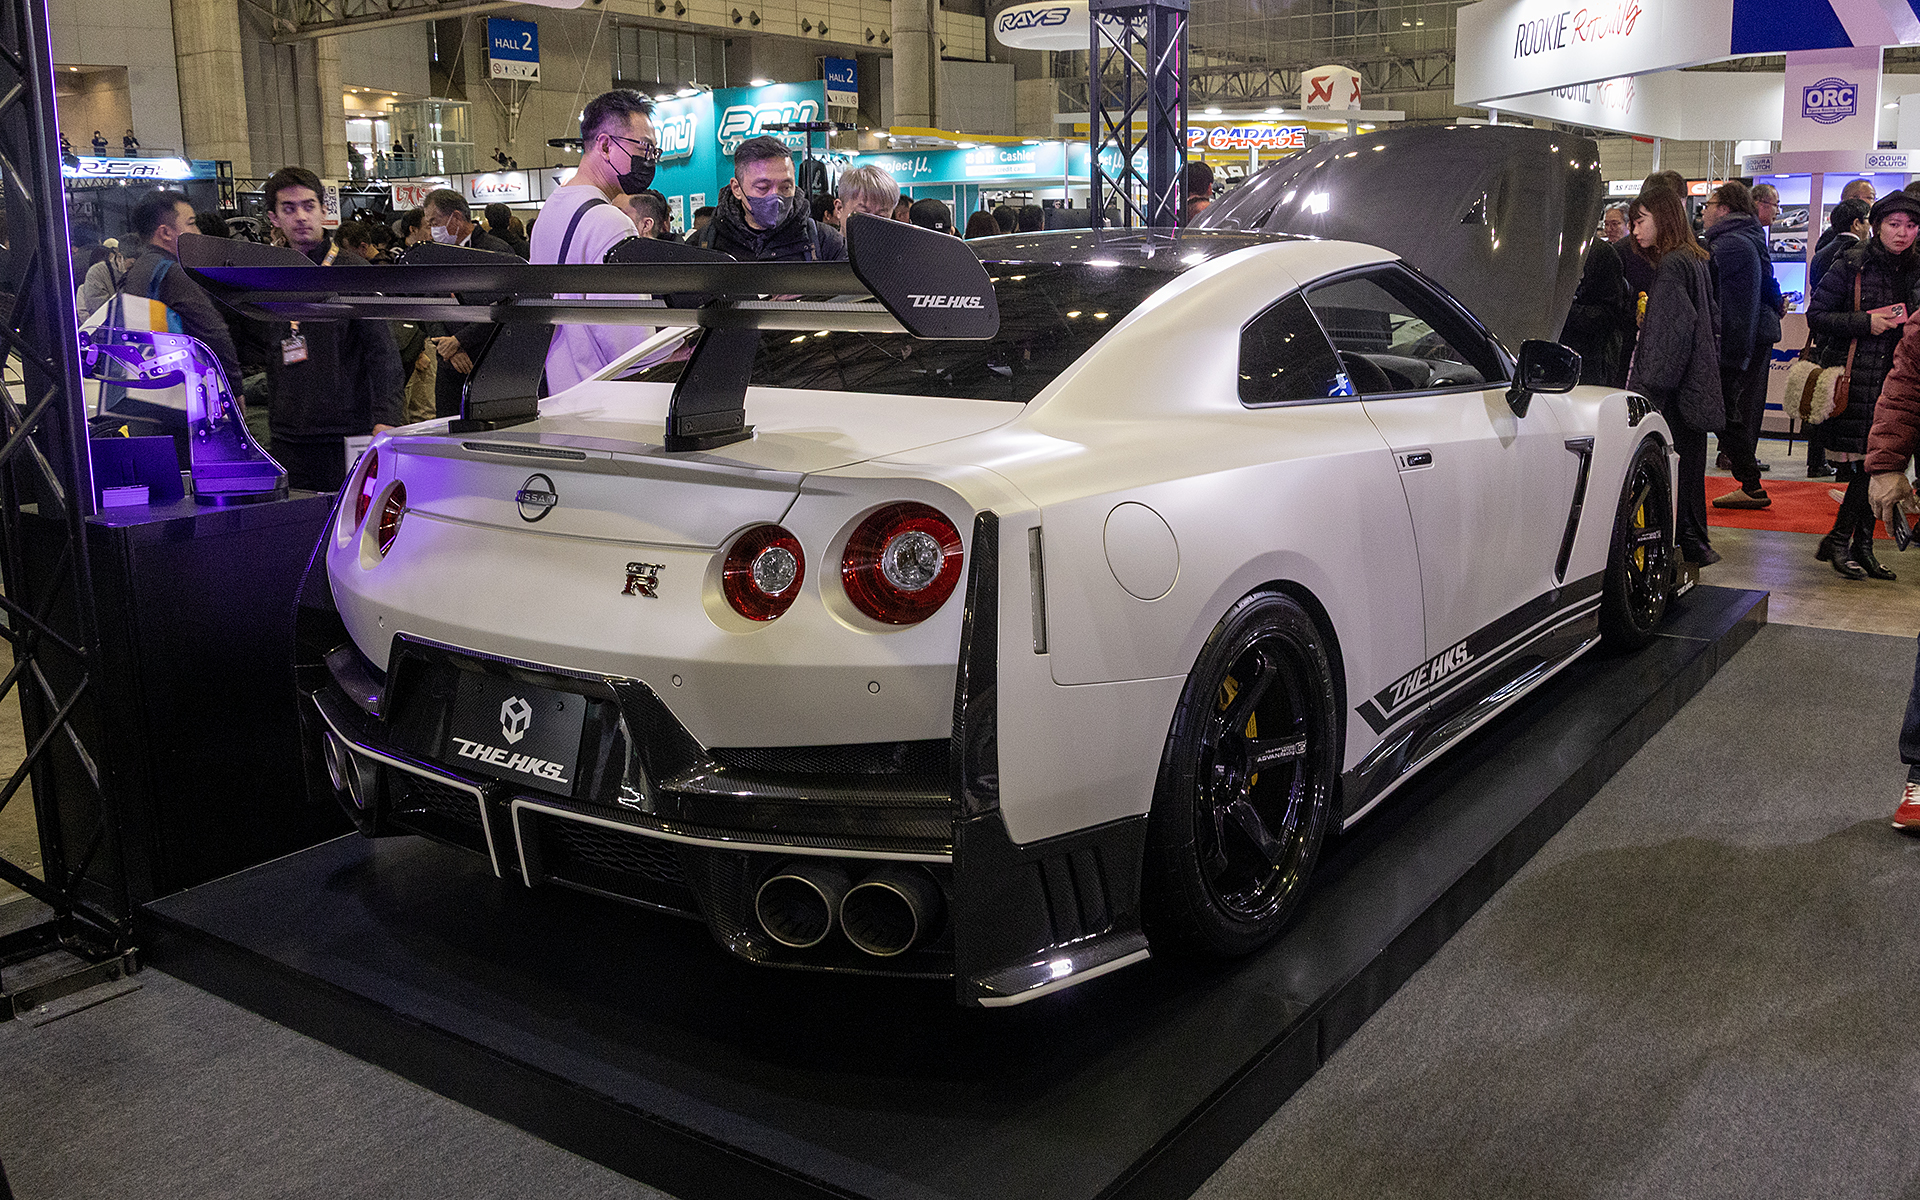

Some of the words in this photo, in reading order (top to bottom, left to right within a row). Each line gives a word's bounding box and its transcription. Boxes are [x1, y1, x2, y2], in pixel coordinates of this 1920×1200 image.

[999, 8, 1070, 32] RAYS
[495, 38, 520, 50] HALL
[522, 32, 533, 51] 2
[1513, 11, 1570, 59] ROOKIE
[828, 73, 845, 83] HALL
[846, 68, 854, 83] 2
[1807, 88, 1853, 108] ORC
[1209, 126, 1307, 148] GARAGE
[1000, 149, 1036, 162] Cashier
[471, 178, 521, 198] VARIS
[518, 491, 556, 504] NISSAN
[1256, 752, 1280, 762] ADVAN
